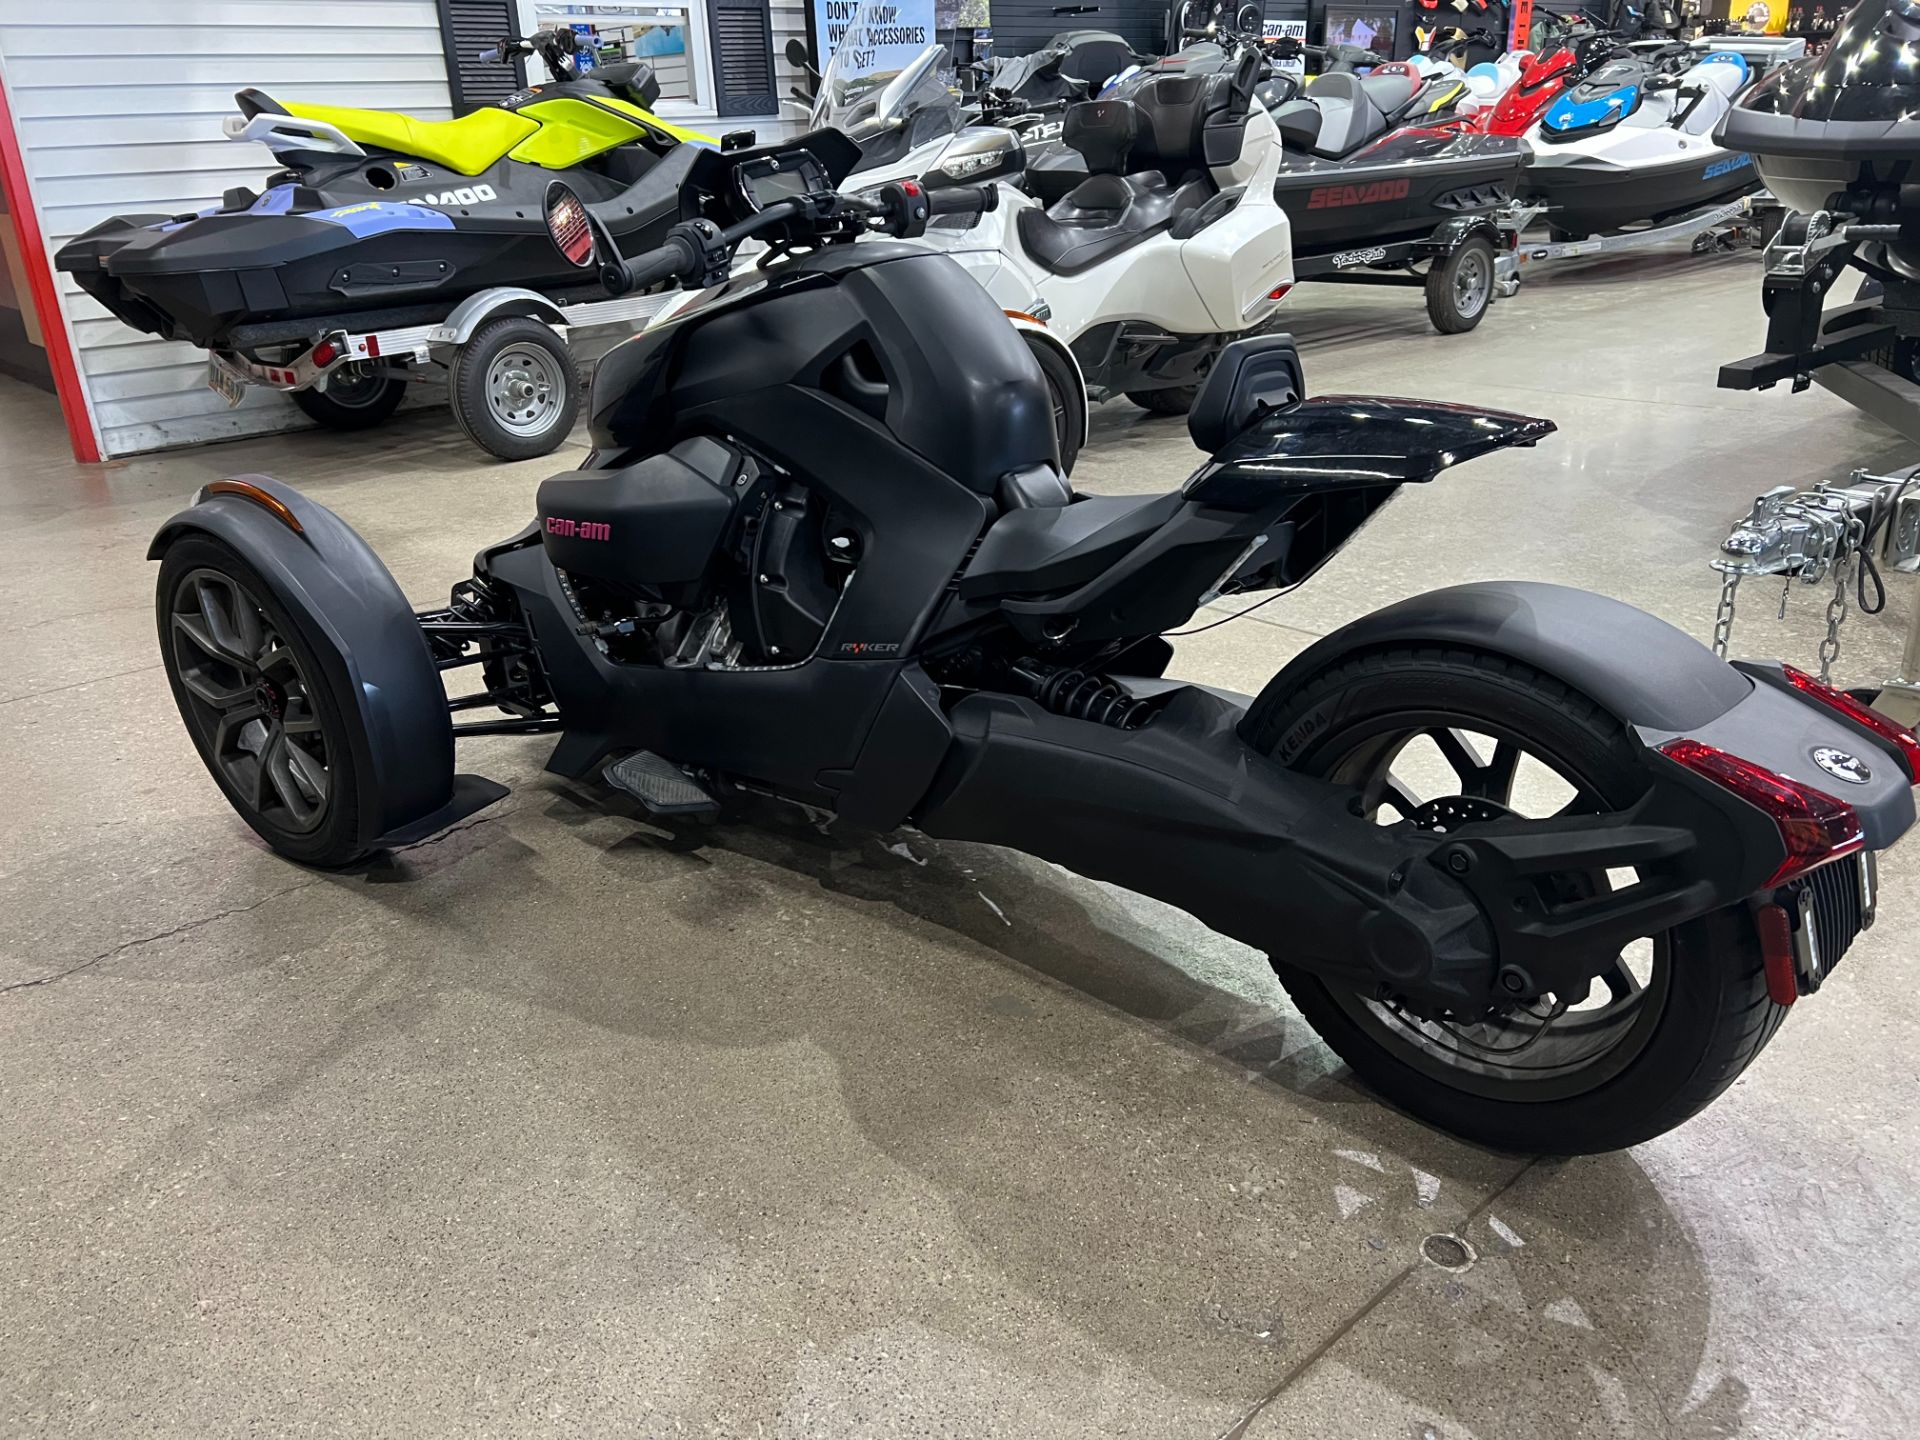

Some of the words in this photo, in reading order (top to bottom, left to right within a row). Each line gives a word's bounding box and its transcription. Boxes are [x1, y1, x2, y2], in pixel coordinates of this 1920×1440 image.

[866, 27, 925, 48] ACCESSORIES
[546, 517, 611, 541] can-am
[840, 642, 900, 654] RYKER
[1278, 711, 1329, 763] KENDA
